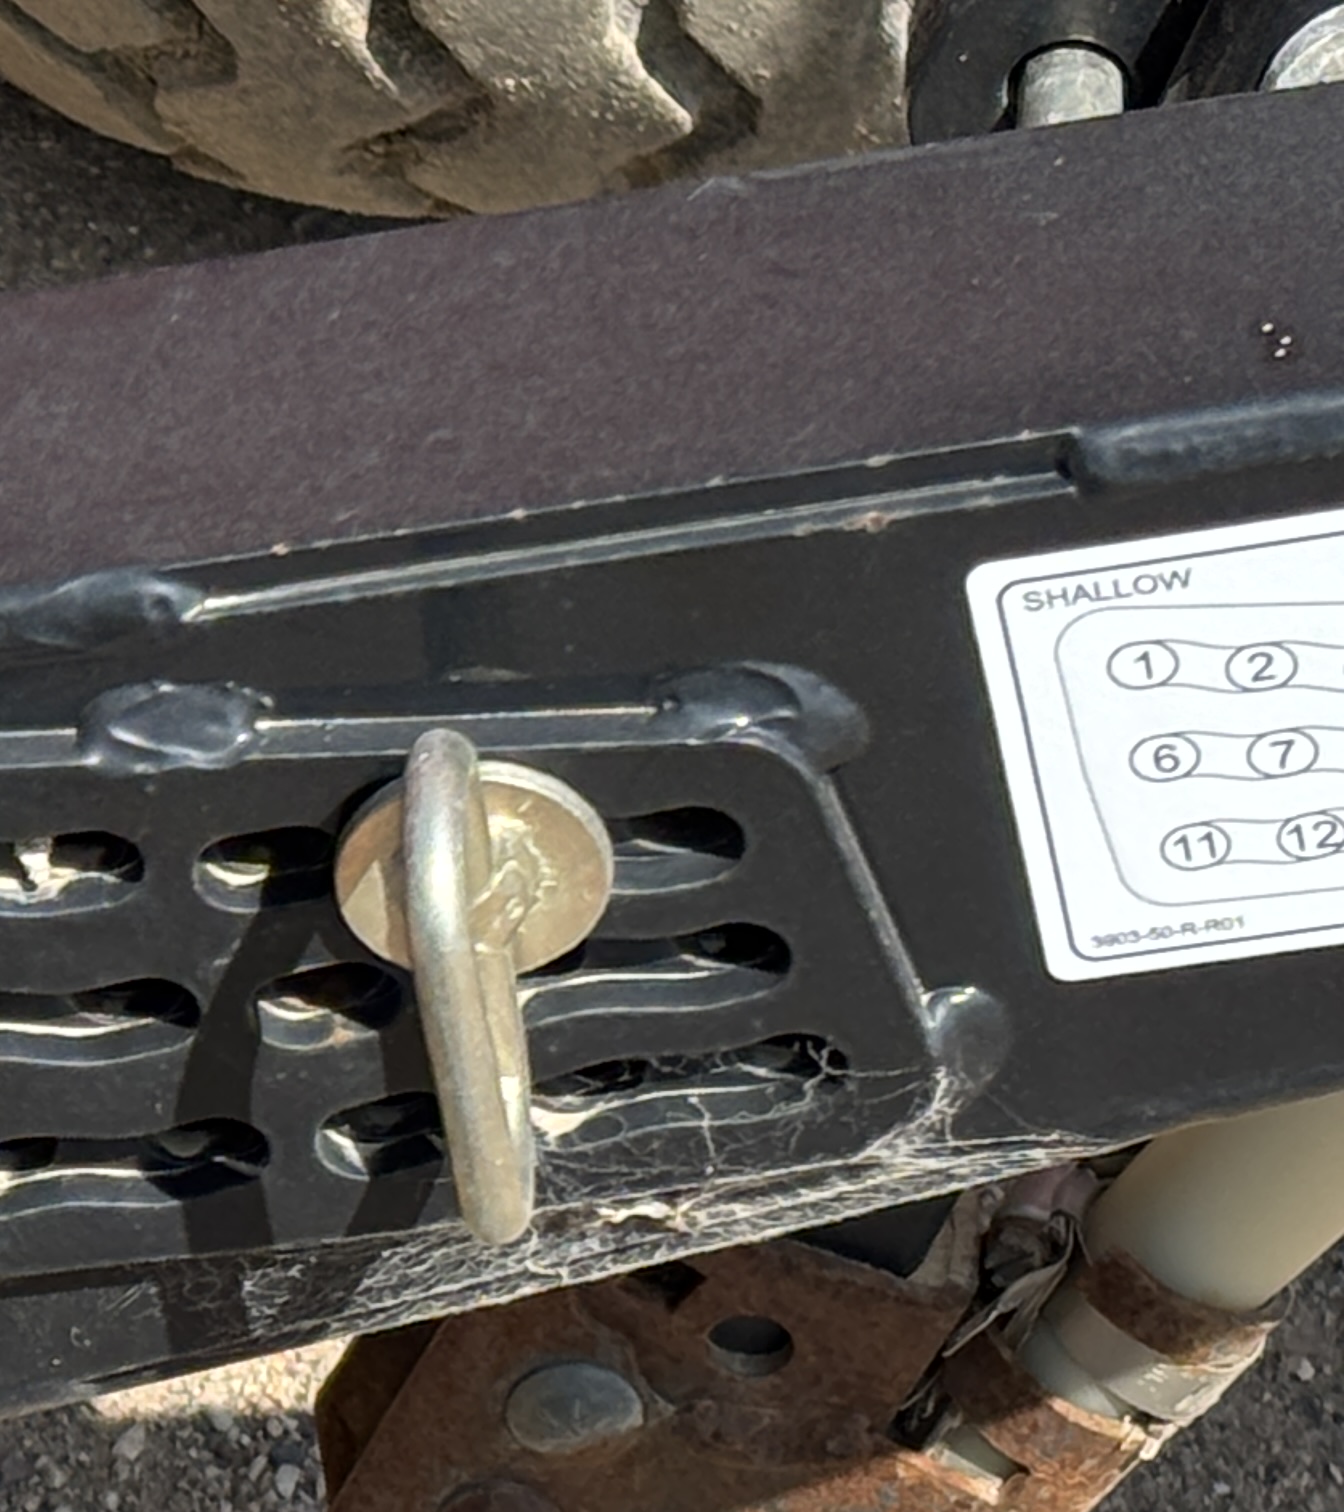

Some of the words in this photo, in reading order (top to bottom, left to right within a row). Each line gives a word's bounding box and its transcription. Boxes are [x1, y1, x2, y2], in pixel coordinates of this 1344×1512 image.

[1022, 567, 1192, 612] SHALLOW
[1133, 650, 1153, 680] 1
[1247, 651, 1277, 682] 2
[1153, 743, 1180, 773] 6
[1269, 739, 1295, 770] 7
[1173, 831, 1217, 862] 11
[1285, 820, 1344, 852] 12
